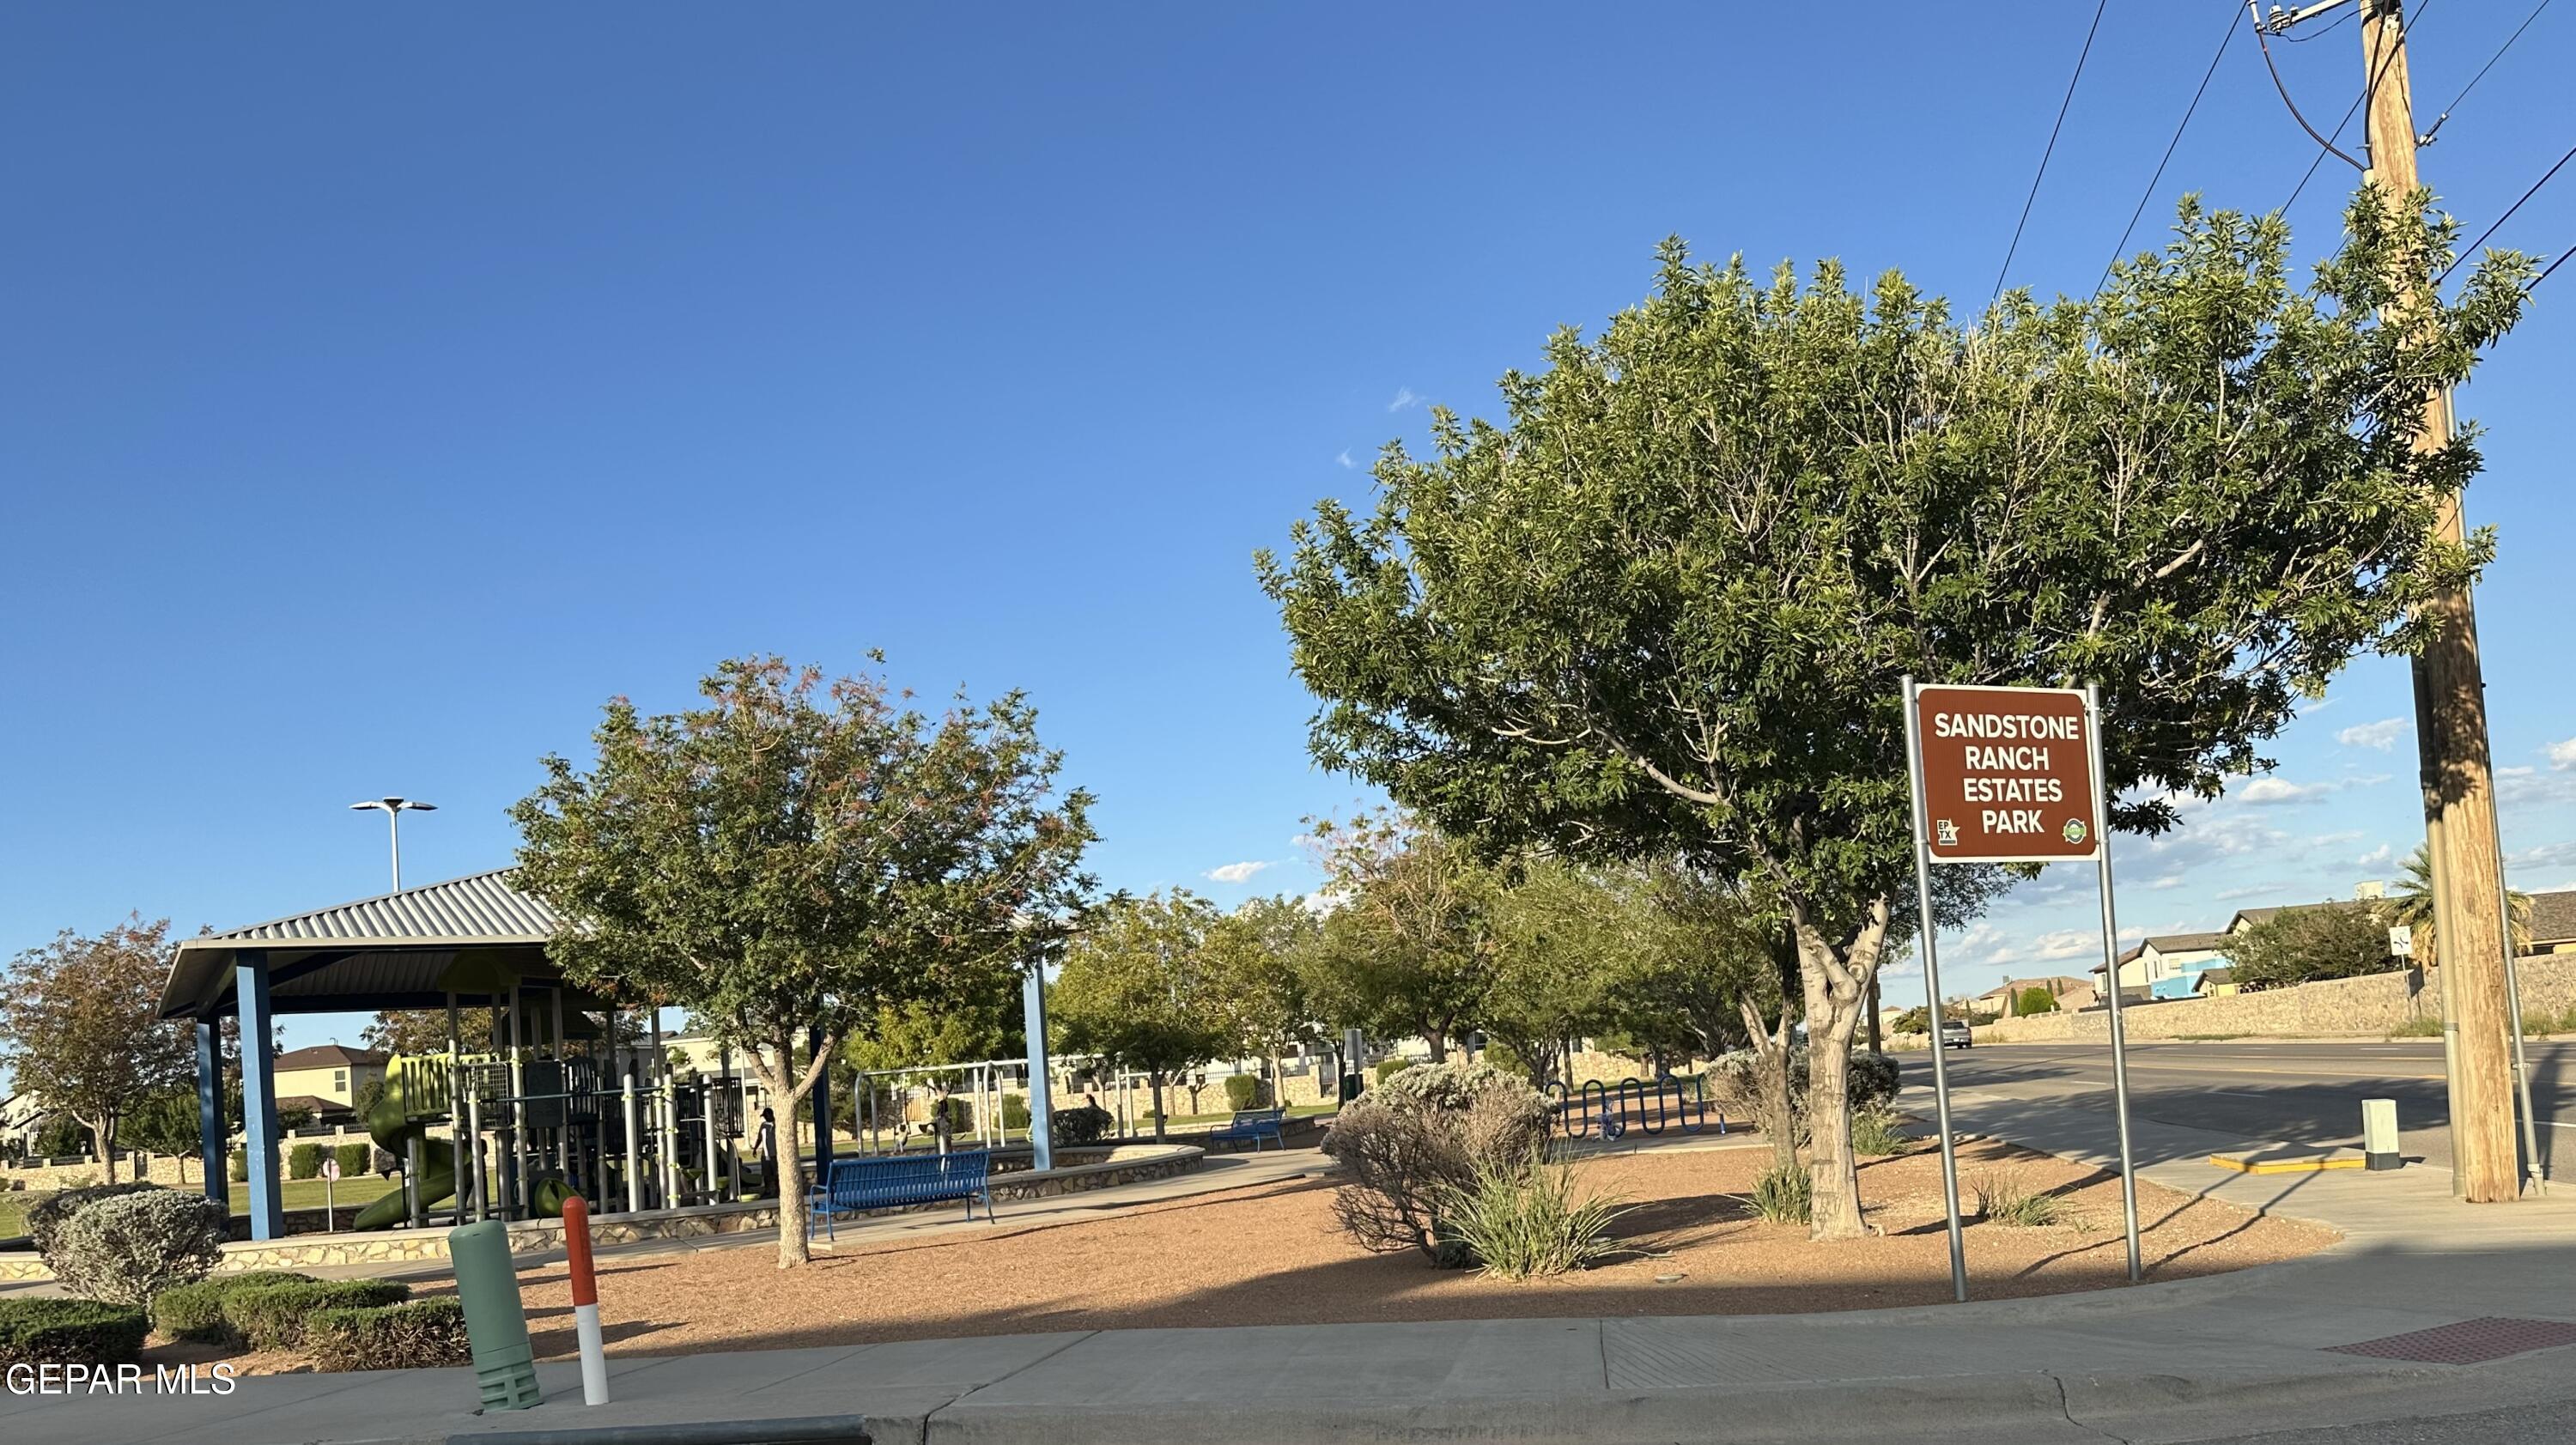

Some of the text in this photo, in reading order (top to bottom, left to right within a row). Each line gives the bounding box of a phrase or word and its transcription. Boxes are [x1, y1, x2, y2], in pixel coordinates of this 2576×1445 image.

[1934, 713, 2080, 740] SANDSTONE
[1965, 745, 2050, 770] RANCH
[1963, 778, 2063, 803] ESTATES
[1938, 821, 1949, 830] EP
[1939, 830, 1951, 839] TX
[1982, 810, 2044, 835] PARK
